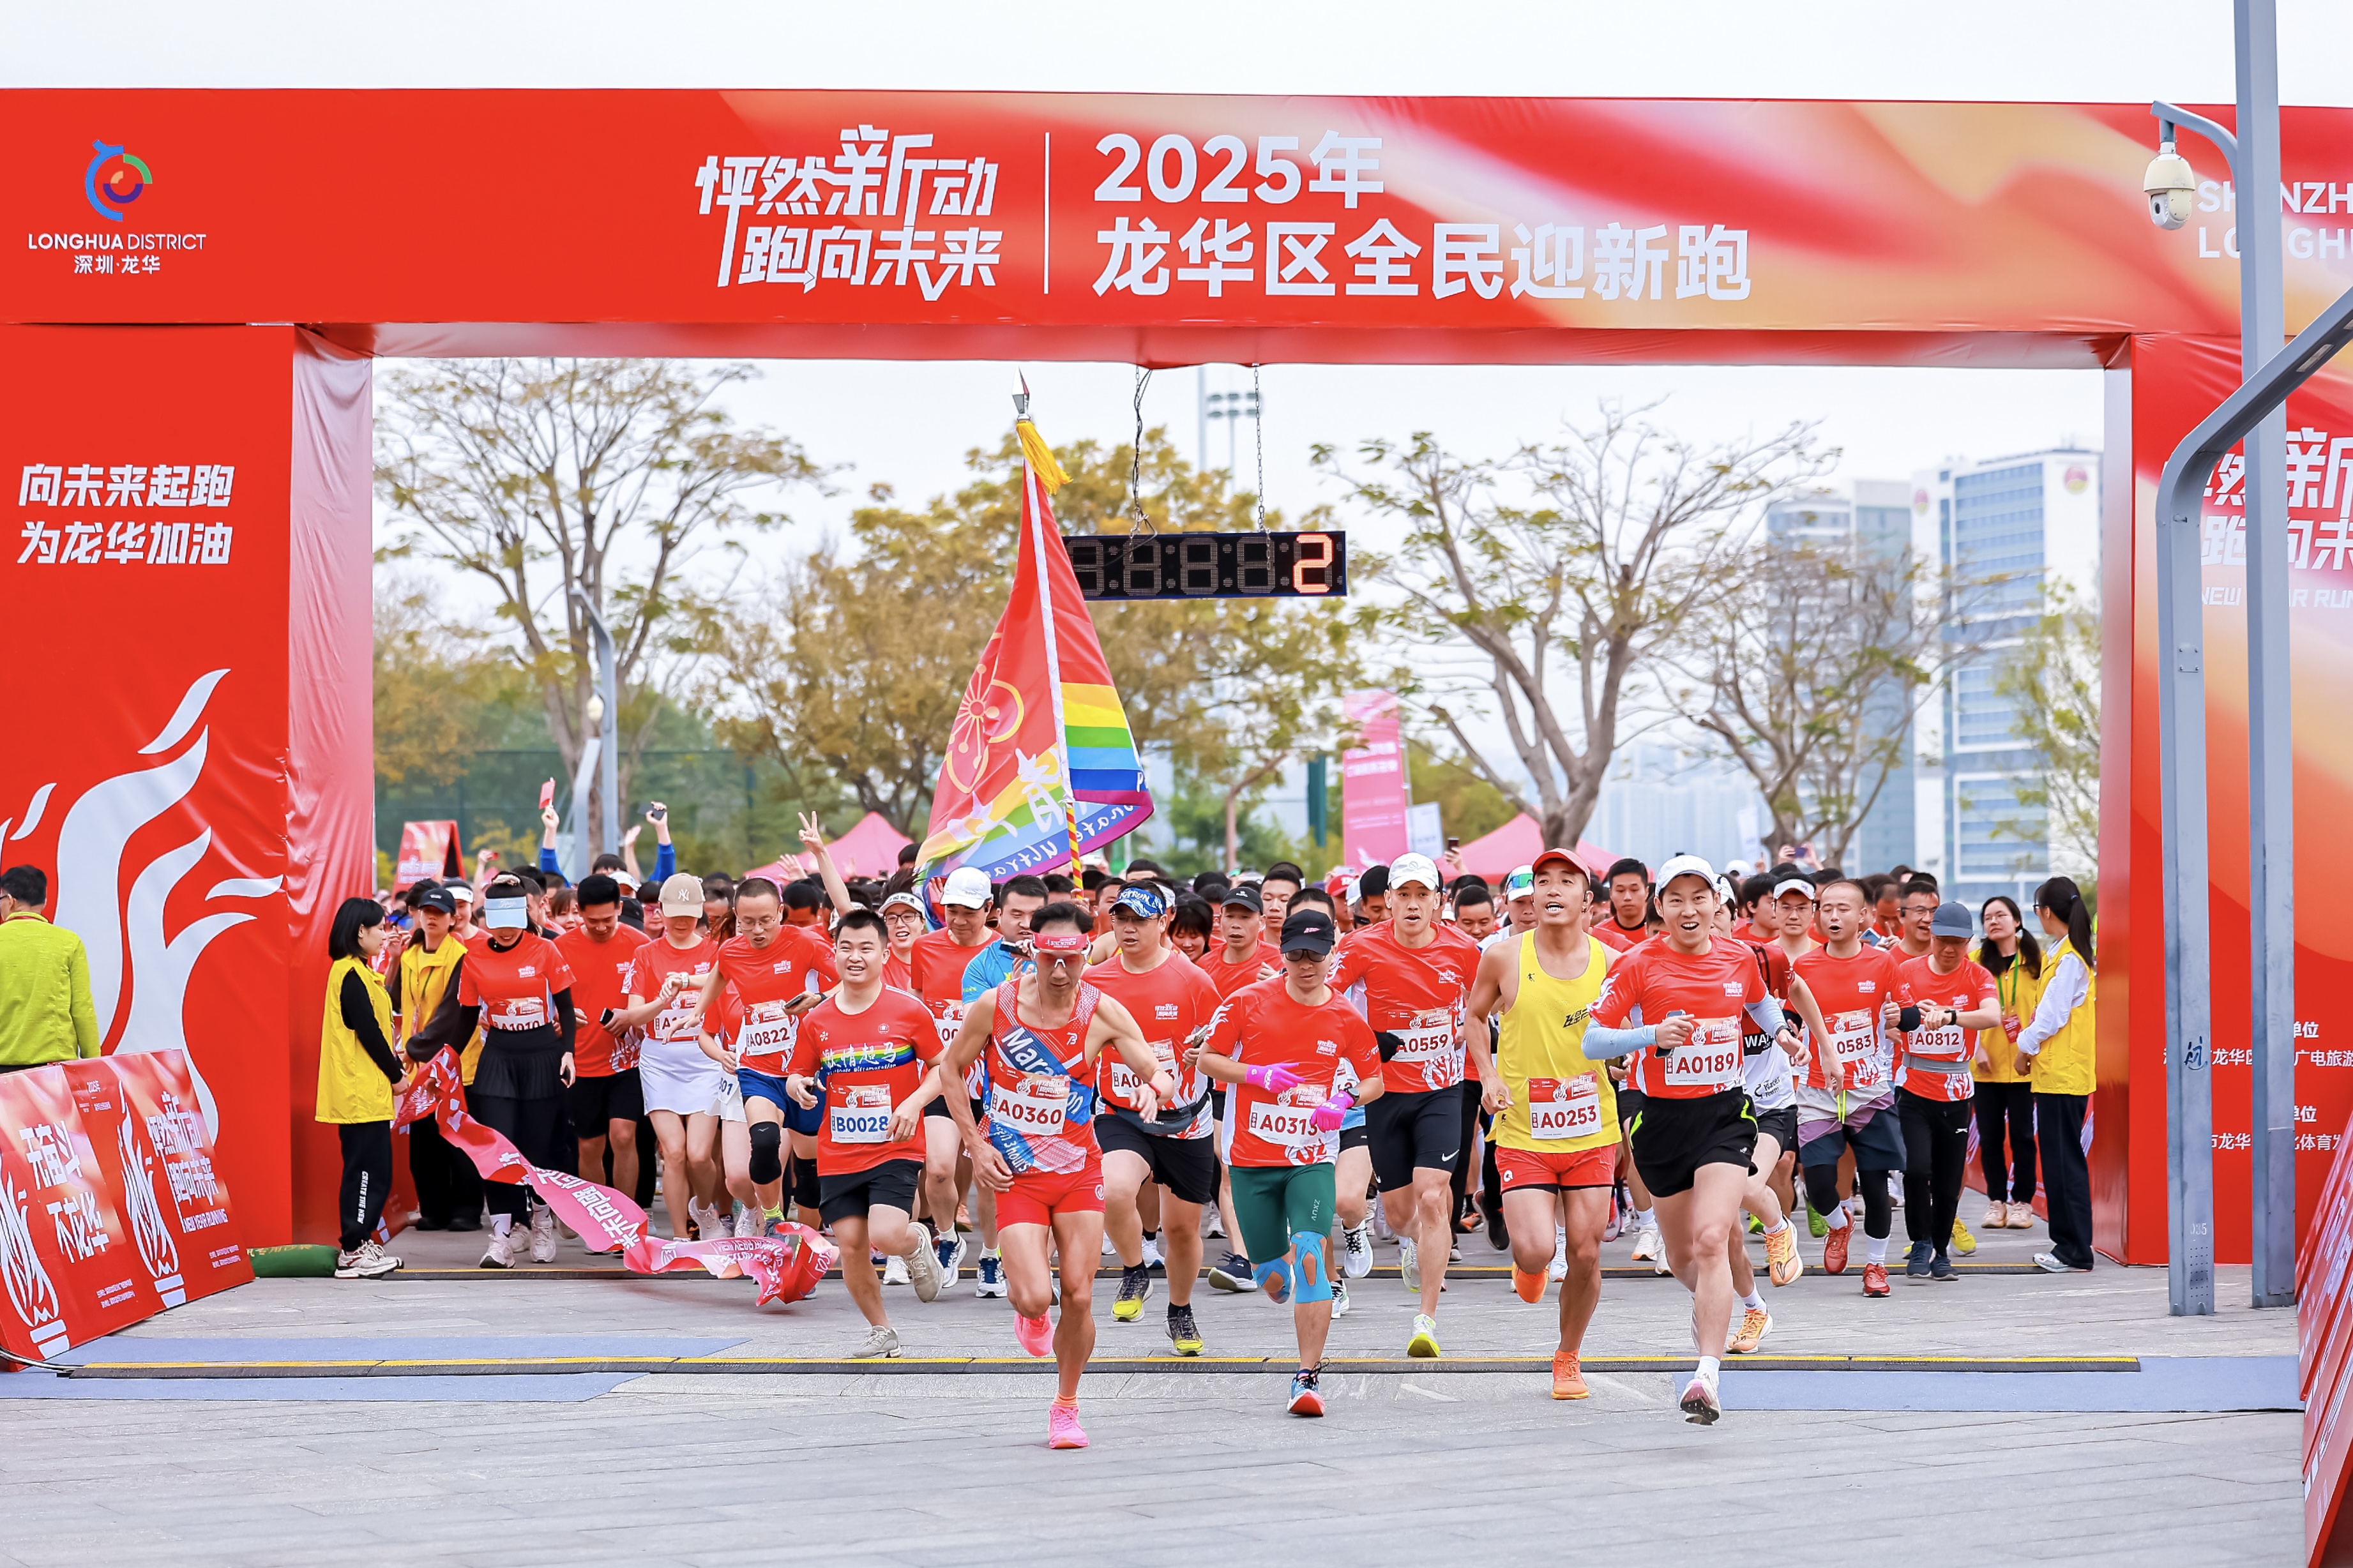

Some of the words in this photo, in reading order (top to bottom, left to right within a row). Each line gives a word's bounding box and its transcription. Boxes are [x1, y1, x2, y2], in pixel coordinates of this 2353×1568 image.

[1094, 130, 1384, 209] 2025年
[695, 124, 999, 288] 怦然新动
[2197, 180, 2353, 214] SNZH
[27, 233, 124, 250] LONGHUA
[128, 233, 207, 250] DISTRICT
[2198, 226, 2353, 259] LOGH
[73, 255, 161, 275] 深圳·龙华
[738, 225, 1003, 301] 跑向未来
[1091, 216, 1752, 301] 龙华区全民迎新跑
[19, 463, 235, 507] 向未来起跑
[17, 521, 234, 565] 为龙华加油
[1292, 534, 1333, 594] 2
[749, 1027, 790, 1046] A0822
[1396, 1034, 1448, 1053] A0559
[1837, 1034, 1871, 1054] 0583
[1915, 1032, 1960, 1046] A0812
[1001, 1026, 1084, 1115] Maraon
[1676, 1053, 1734, 1074] A0189
[836, 1116, 888, 1133] B0028
[997, 1099, 1063, 1124] A0360
[1541, 1104, 1596, 1128] A0253
